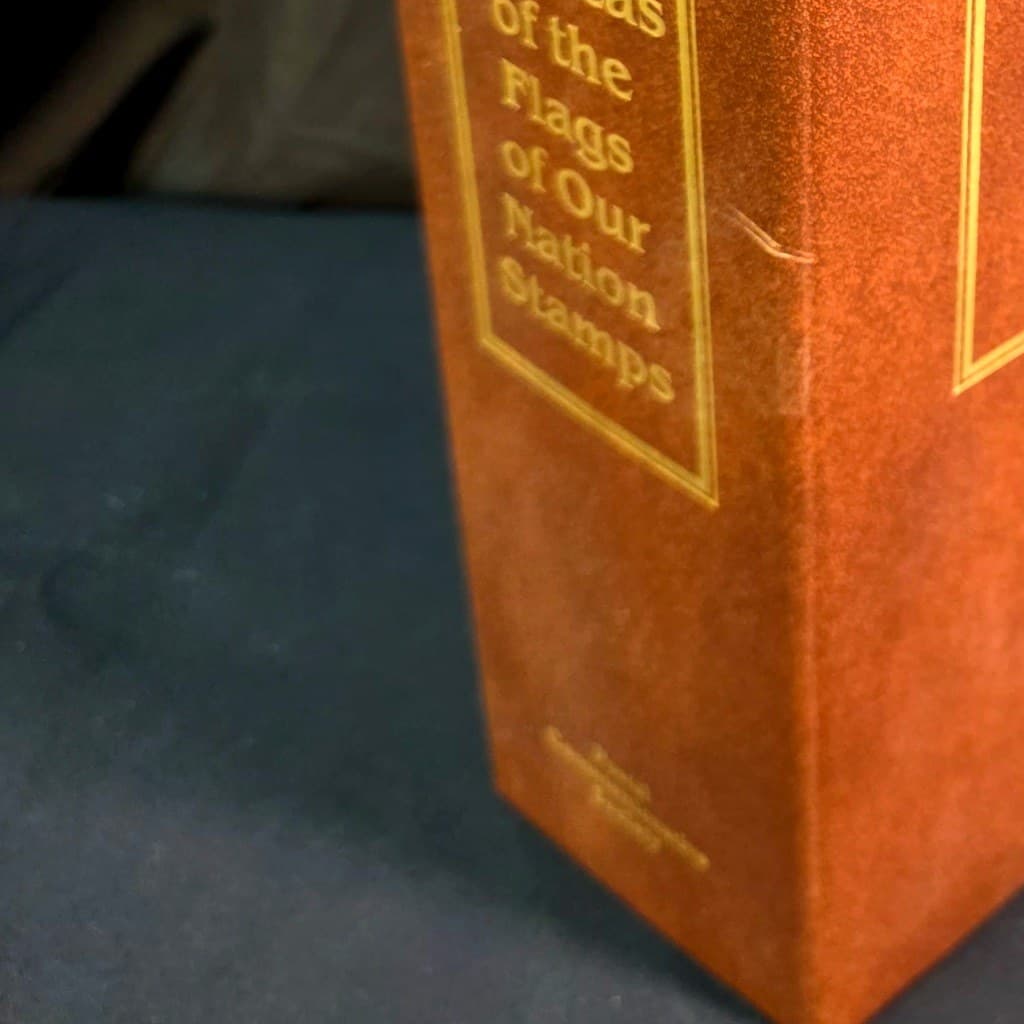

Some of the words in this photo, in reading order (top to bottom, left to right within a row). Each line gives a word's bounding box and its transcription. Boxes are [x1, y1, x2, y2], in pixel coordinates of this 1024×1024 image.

[500, 57, 635, 174] Flags
[547, 15, 634, 103] the
[500, 140, 547, 192] of
[555, 168, 651, 254] Our
[502, 192, 662, 332] Nation
[498, 256, 676, 404] Stamps
